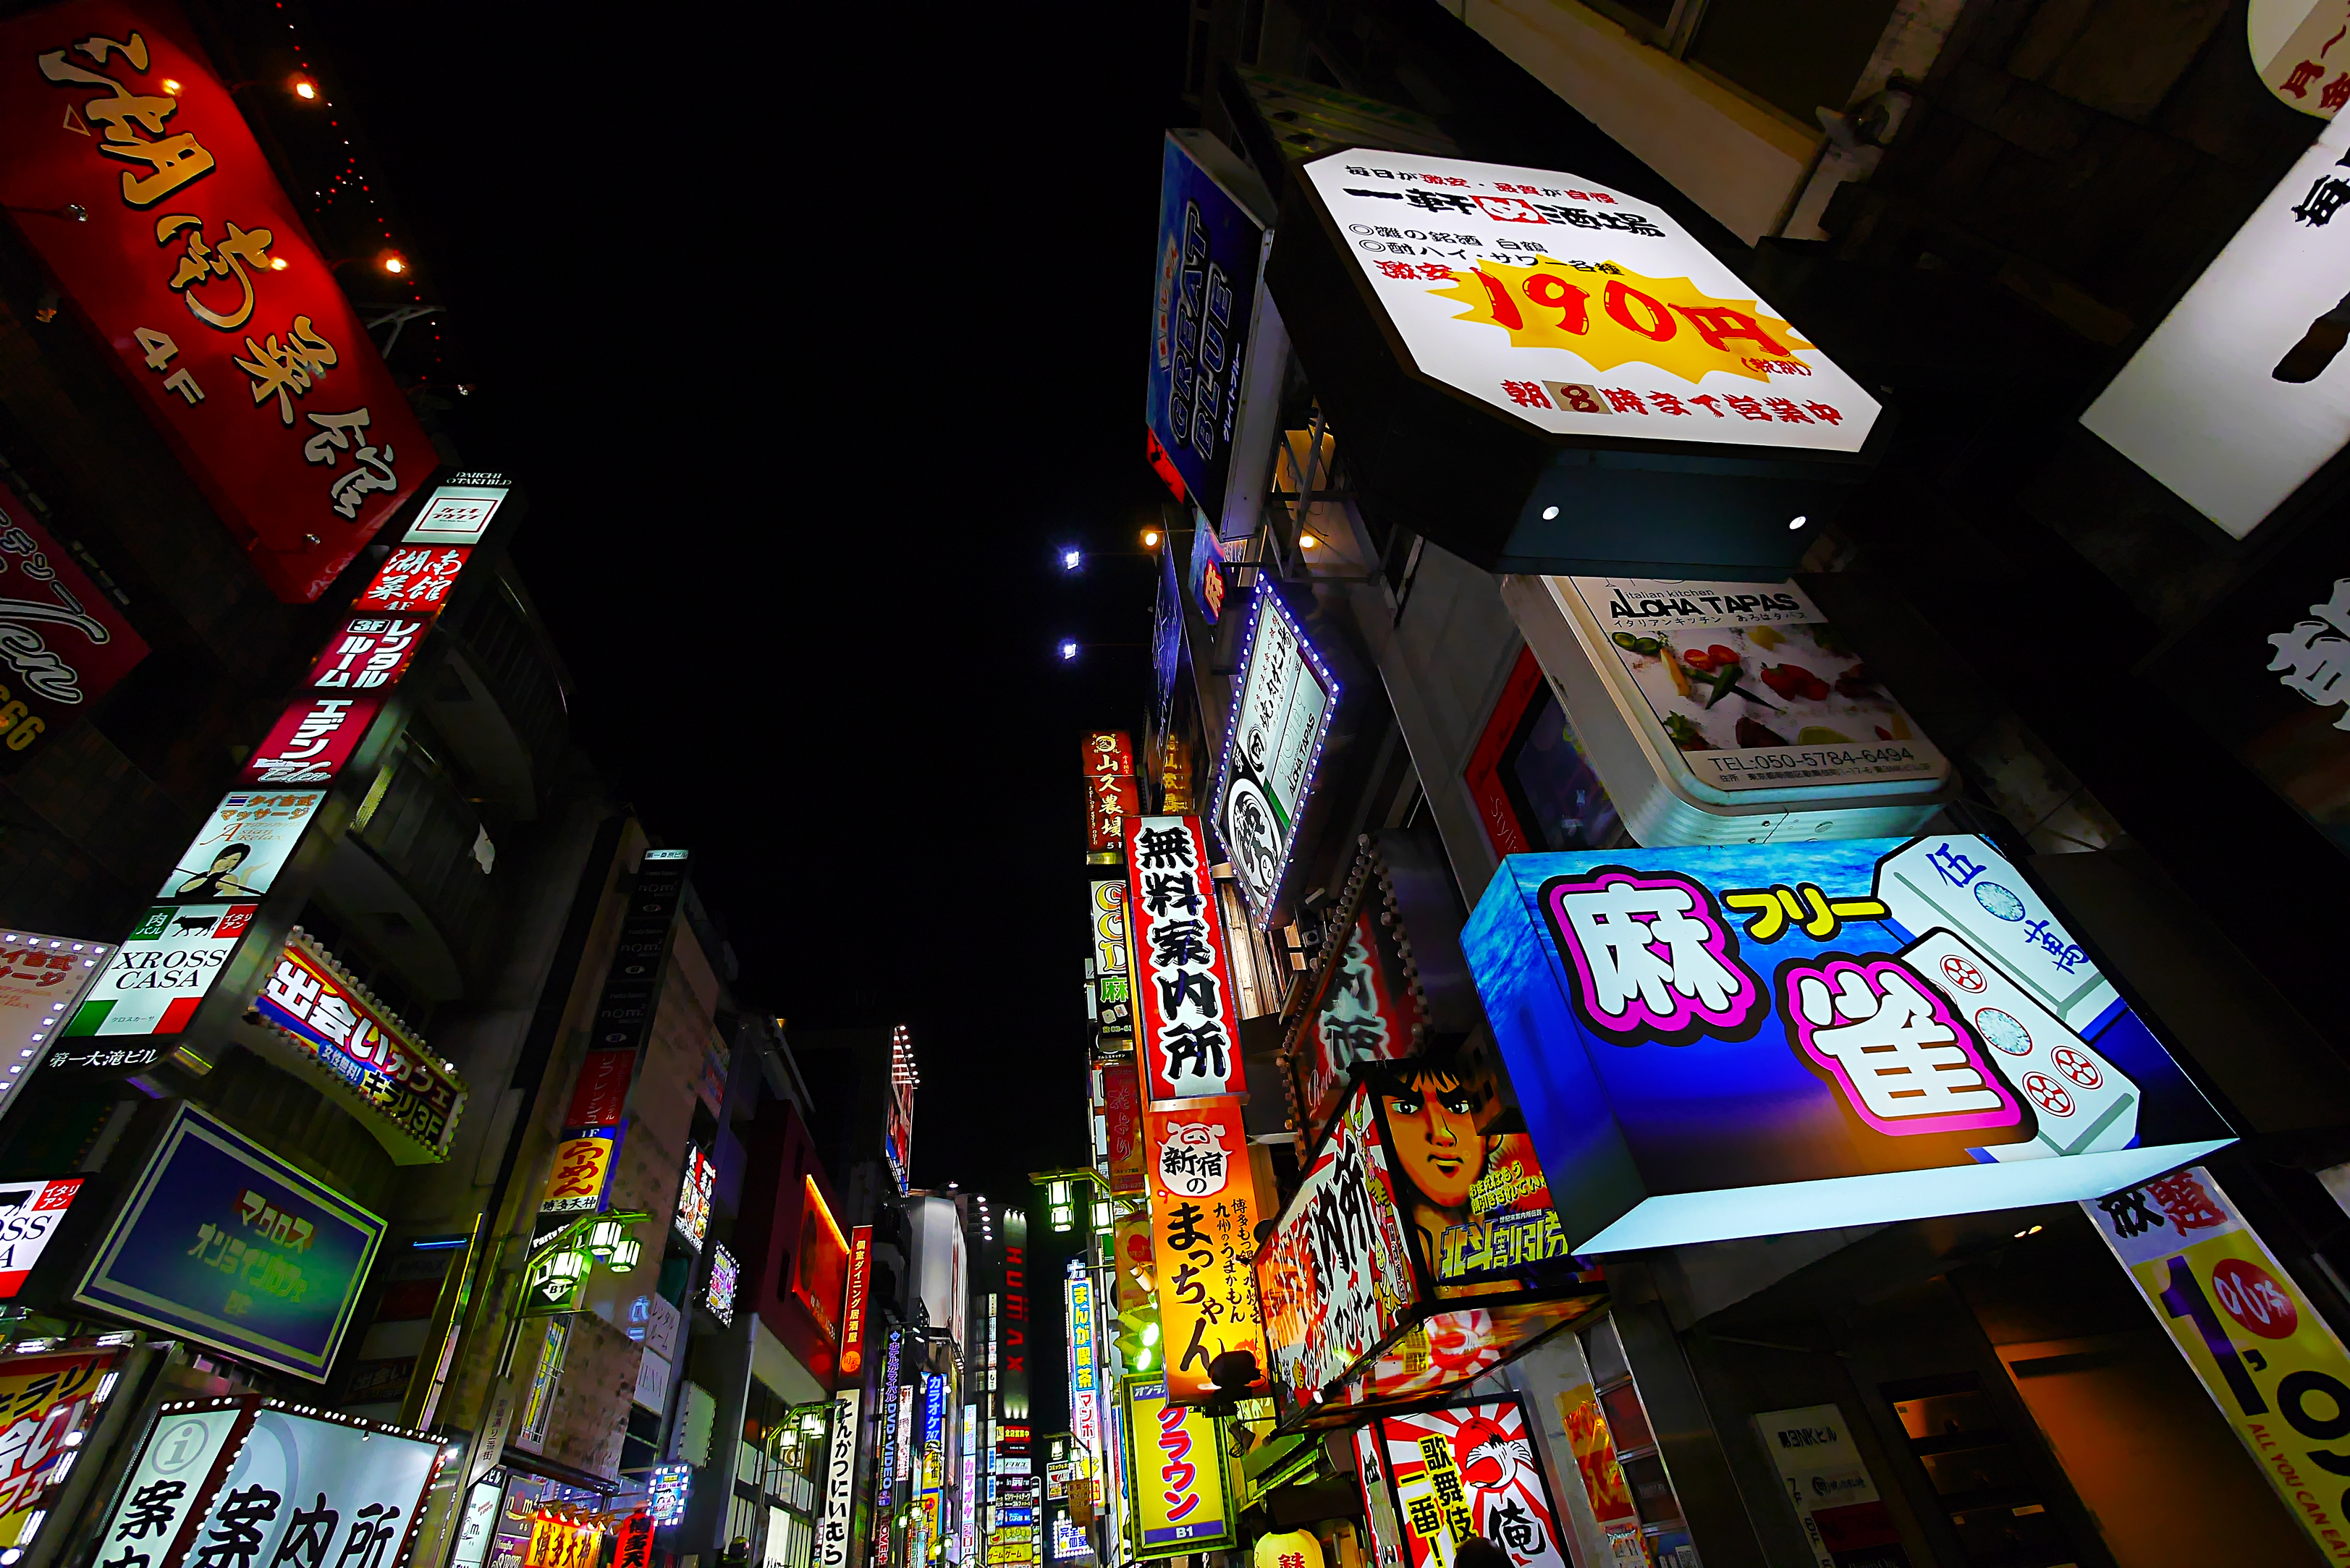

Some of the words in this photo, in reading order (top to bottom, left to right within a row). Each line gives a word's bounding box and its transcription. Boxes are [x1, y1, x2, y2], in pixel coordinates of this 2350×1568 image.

[1374, 259, 1461, 283] 激安
[1170, 199, 1209, 440] GREAT
[1471, 266, 1790, 359] 190円
[132, 326, 205, 404] 4F
[1193, 261, 1233, 463] BLUE
[1501, 378, 1844, 428] 朝8時まで営業中
[383, 601, 415, 611] 4F
[1609, 588, 1707, 619] ALOHA
[1699, 593, 1801, 615] TAPAS
[1625, 590, 1665, 601] italian
[1668, 588, 1715, 598] kitchen
[353, 619, 384, 632] 3F
[1613, 616, 1723, 628] イタリアンキッチン
[314, 635, 376, 688] ルーム
[352, 619, 421, 688] レンタル
[279, 699, 355, 760] エデン
[1300, 712, 1316, 755] TAPAS
[257, 761, 331, 783] Eden
[1707, 747, 1915, 772] TEL:050-5784-6494
[221, 807, 310, 821] マッサージ
[136, 925, 164, 936] バル
[146, 912, 166, 929] 肉
[221, 920, 245, 931] アン
[224, 912, 253, 923] イタリ
[1725, 890, 1888, 939] フリー
[0, 946, 78, 971] イ古式
[111, 949, 229, 971] XROSS
[1138, 826, 1228, 1079] 無料案内所
[115, 970, 200, 991] CASA
[1562, 881, 2005, 1120] 麻雀
[110, 1014, 156, 1023] クロスカーサ
[265, 959, 455, 1111] 出会いカフェ
[48, 1048, 159, 1069] 第一大滝ビル
[321, 1043, 363, 1081] 女性無料!
[1162, 1145, 1224, 1179] 新宿
[1468, 1159, 1523, 1200] おまえはもう
[39, 1196, 68, 1210] アン
[45, 1184, 80, 1196] イタリ
[543, 1197, 597, 1212] 博多天神
[1186, 1177, 1207, 1195] の
[242, 1190, 314, 1255] マクロス
[1212, 1201, 1246, 1324] 九州のうまかもん
[549, 1285, 565, 1294] B1
[847, 1239, 867, 1344] 個室ダイニング居酒屋
[1166, 1201, 1225, 1373] まっちゃん
[1073, 1284, 1094, 1390] まんが喫茶
[884, 1342, 900, 1403] ホテルがライバル
[926, 1376, 941, 1431] カラオケ
[1079, 1392, 1095, 1449] マンボー
[926, 1430, 938, 1441] 747
[824, 1399, 853, 1566] とんかつにいむら
[1157, 1405, 1201, 1522] クラウン
[2247, 1422, 2268, 1452] ALL
[2270, 1451, 2306, 1490] YOU
[2295, 1489, 2333, 1526] CAN
[963, 1458, 975, 1519] カラオケ
[1419, 1435, 1478, 1548] 歌舞伎
[190, 1483, 401, 1568] 案内所
[1176, 1525, 1193, 1538] B1
[1400, 1472, 1443, 1568] 一番!
[1488, 1497, 1548, 1556] 俺
[1005, 1549, 1022, 1559] ゲーム
